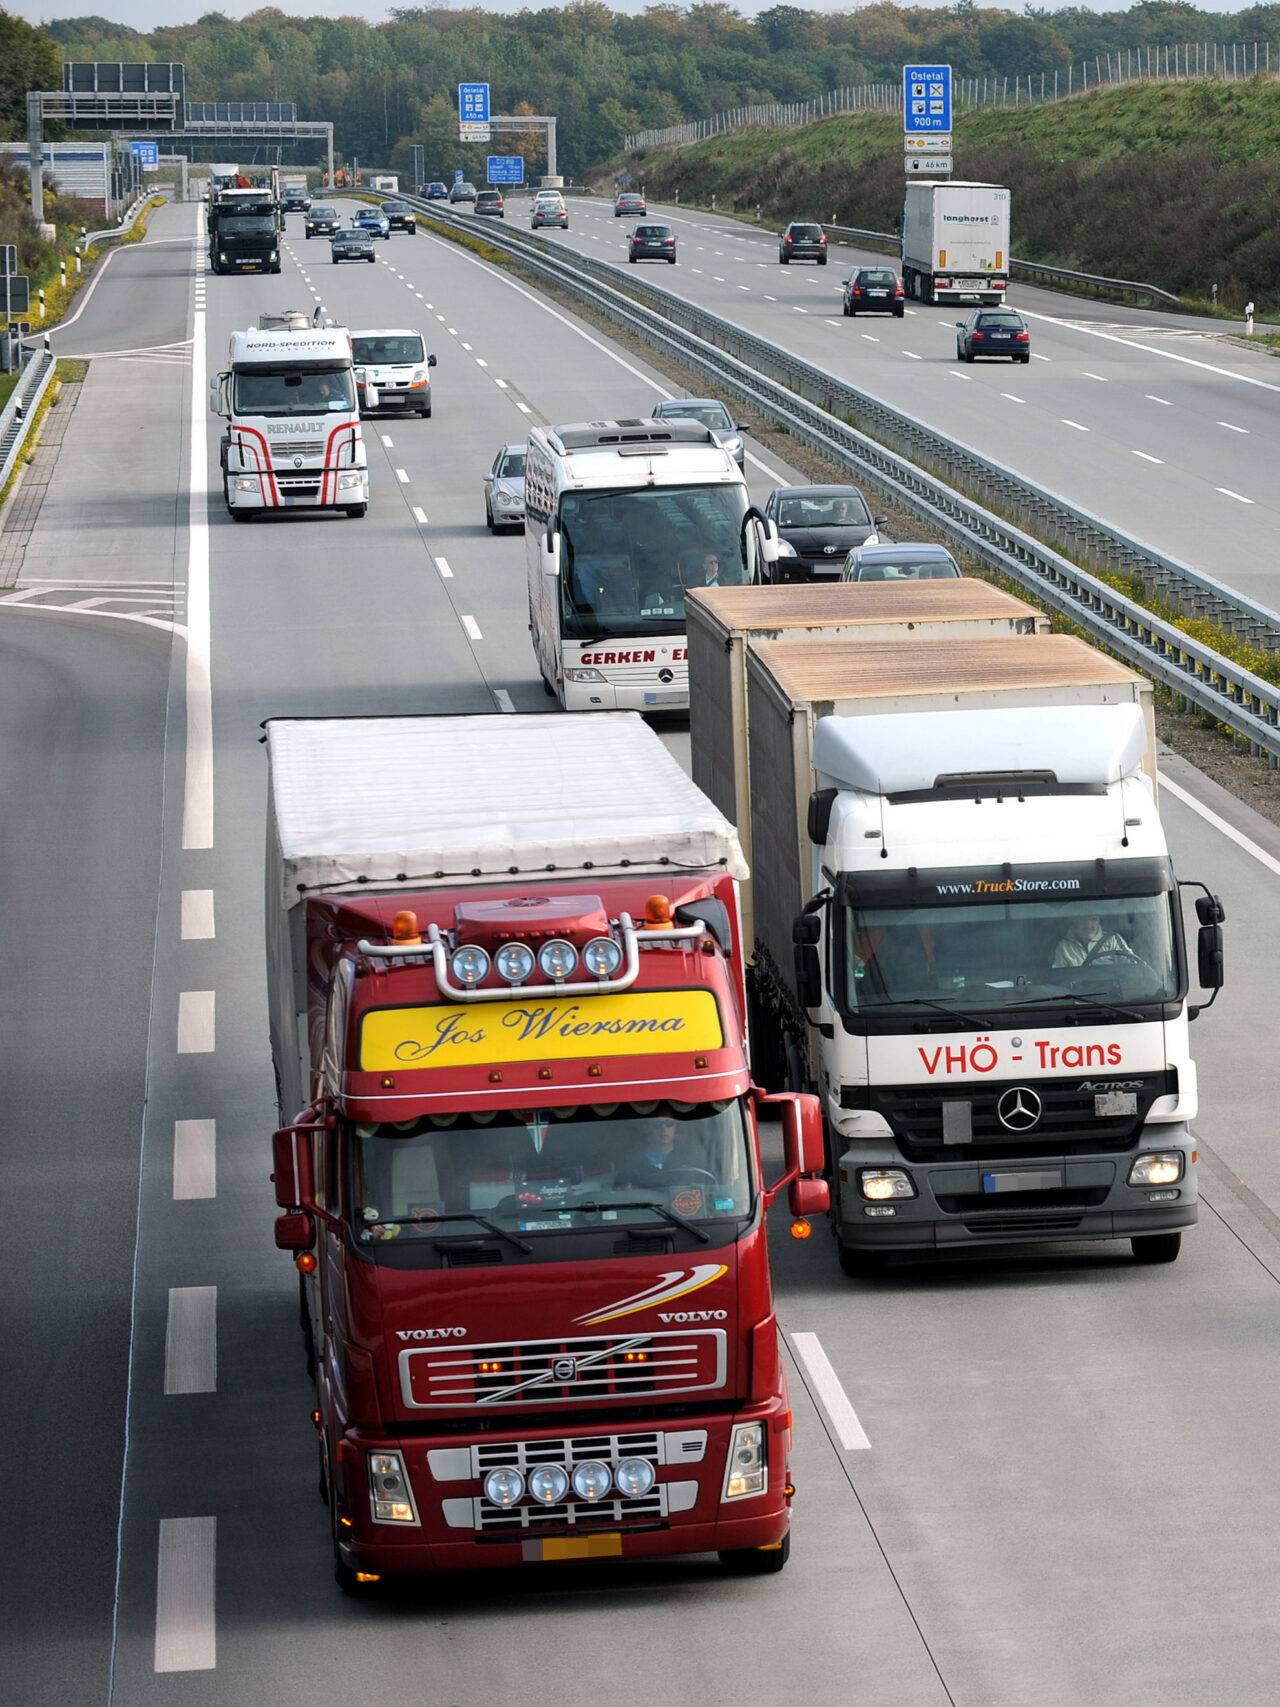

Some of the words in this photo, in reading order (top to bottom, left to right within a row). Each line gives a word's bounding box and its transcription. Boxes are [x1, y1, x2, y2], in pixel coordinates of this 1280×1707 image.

[911, 72, 944, 80] Ostetal
[914, 117, 931, 126] 900
[943, 215, 989, 223] langhorst
[246, 340, 335, 349] NORD-SPEDITION
[267, 422, 325, 434] RENAULT
[580, 650, 656, 665] GERKEN
[936, 879, 1081, 895] www.TruckStore.com
[394, 1012, 487, 1062] Jos
[501, 1006, 686, 1041] Wiersma
[918, 1036, 998, 1075] VHÖ
[1034, 1041, 1122, 1069] Trans
[657, 1309, 728, 1323] VOLVO
[395, 1326, 467, 1341] VOLVO
